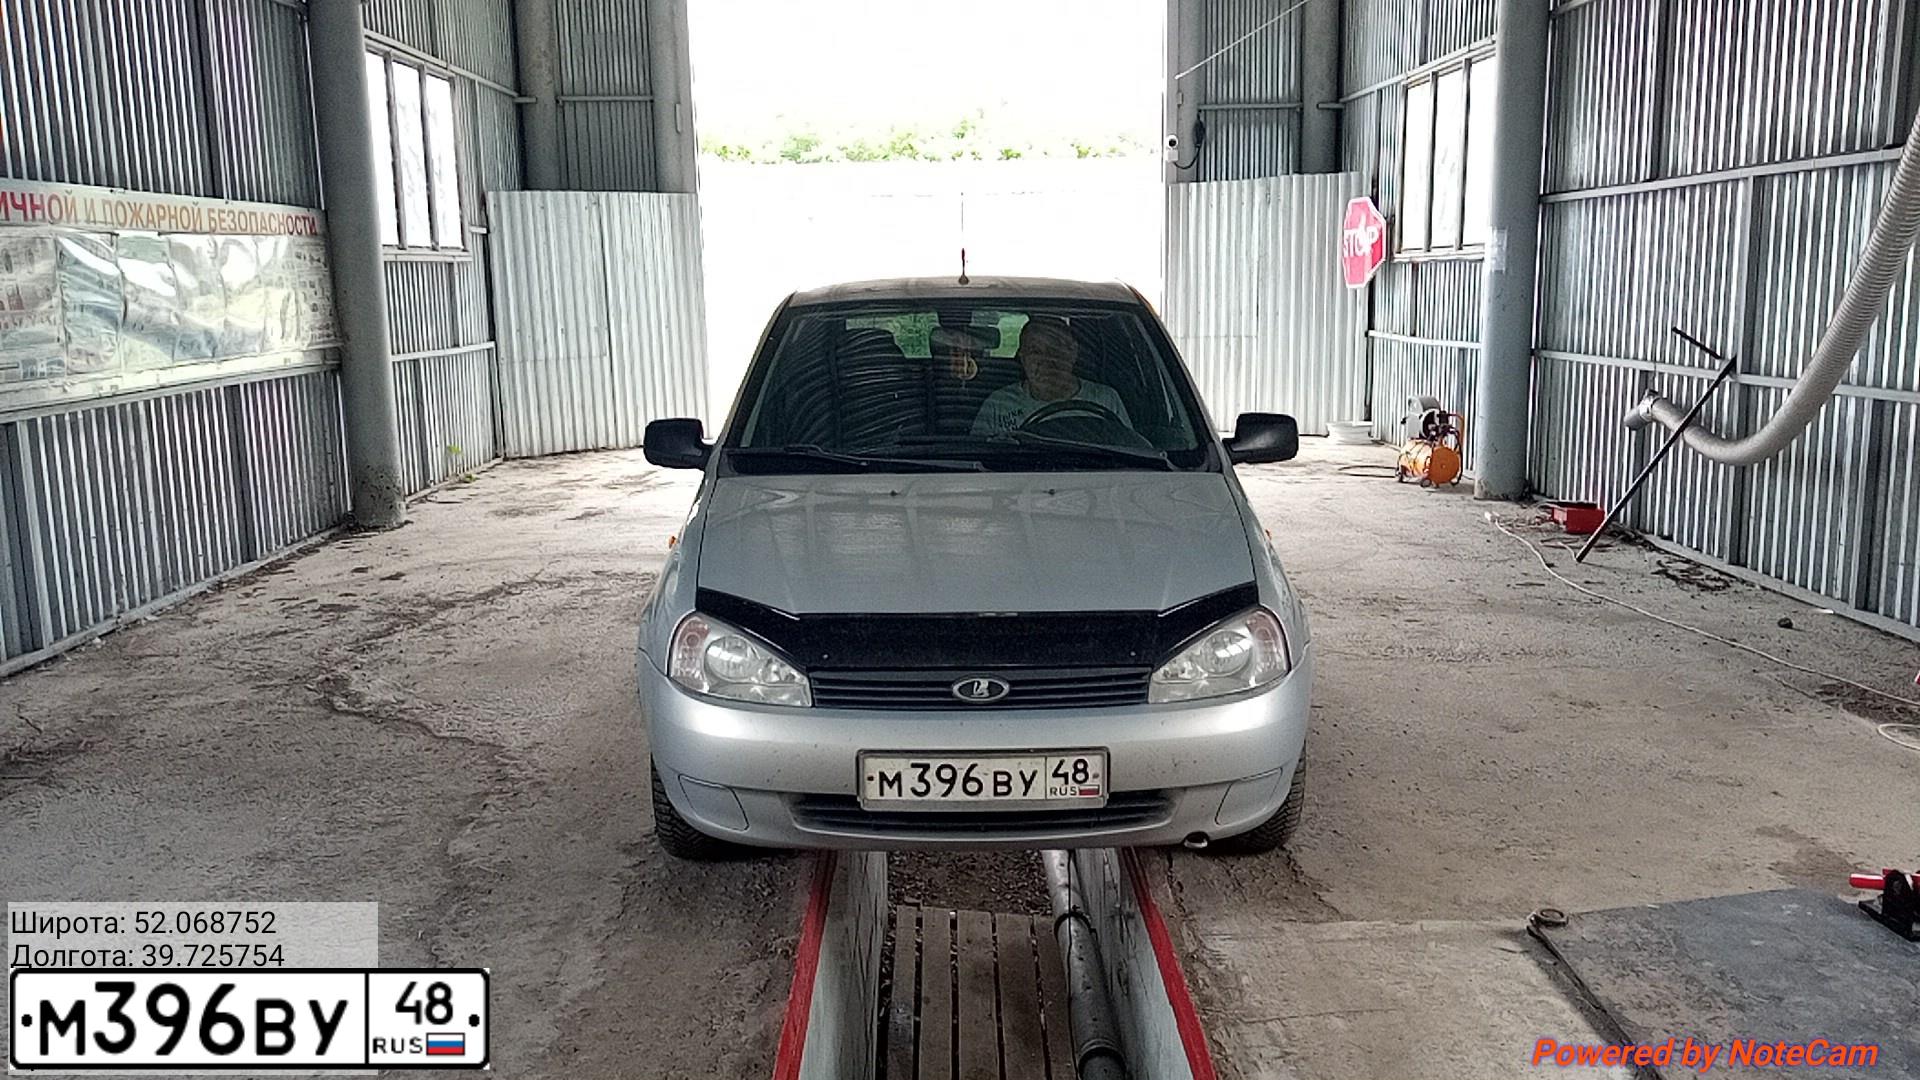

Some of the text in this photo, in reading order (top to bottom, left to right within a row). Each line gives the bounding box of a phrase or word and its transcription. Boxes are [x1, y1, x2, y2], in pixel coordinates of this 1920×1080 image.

[83, 197, 97, 225] И
[102, 198, 203, 234] ПОЖАРНОЙ
[208, 207, 318, 236] БЕЗОПАСНОСТИ
[1344, 225, 1380, 257] STOP
[1051, 758, 1090, 785] 48
[1050, 786, 1078, 796] RUS
